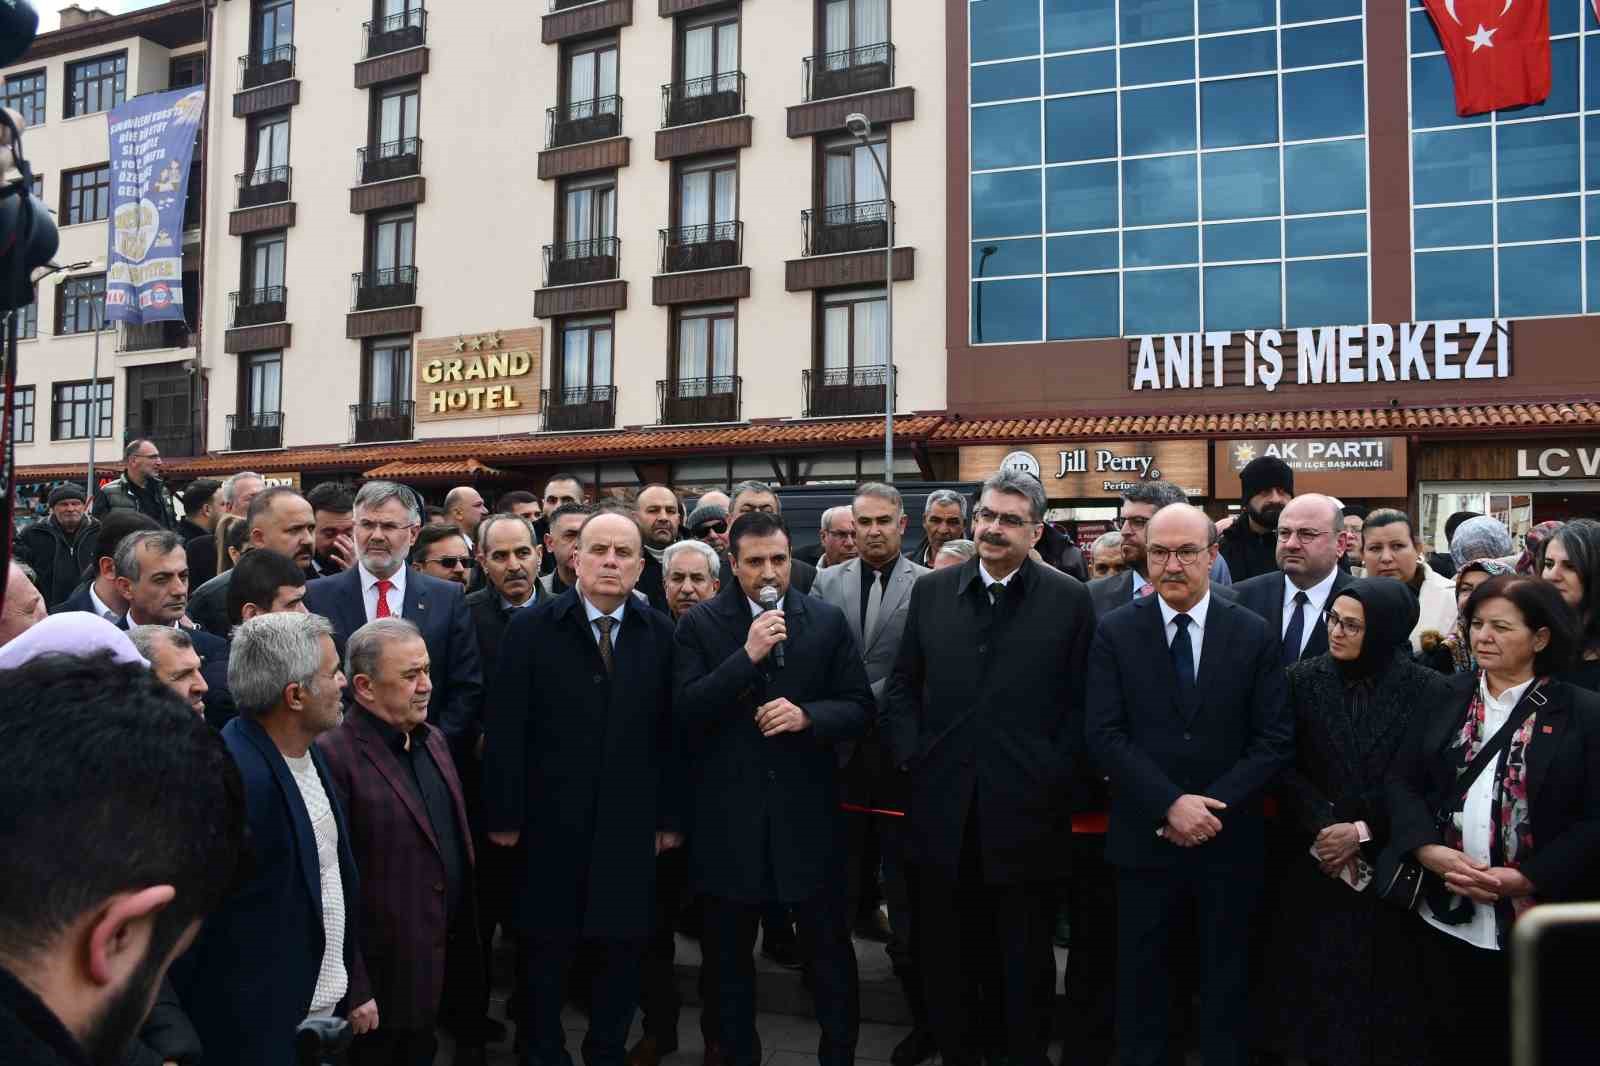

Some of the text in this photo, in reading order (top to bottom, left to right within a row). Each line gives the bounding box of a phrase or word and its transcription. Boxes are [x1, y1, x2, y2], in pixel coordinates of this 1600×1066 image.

[422, 352, 531, 383] GRAND
[1133, 319, 1509, 392] ANIT İŞ MERKEZİ
[430, 384, 520, 413] HOTEL
[1056, 449, 1152, 479] Jill Perry
[1264, 441, 1383, 459] AK PARTİ
[1517, 448, 1571, 478] LC
